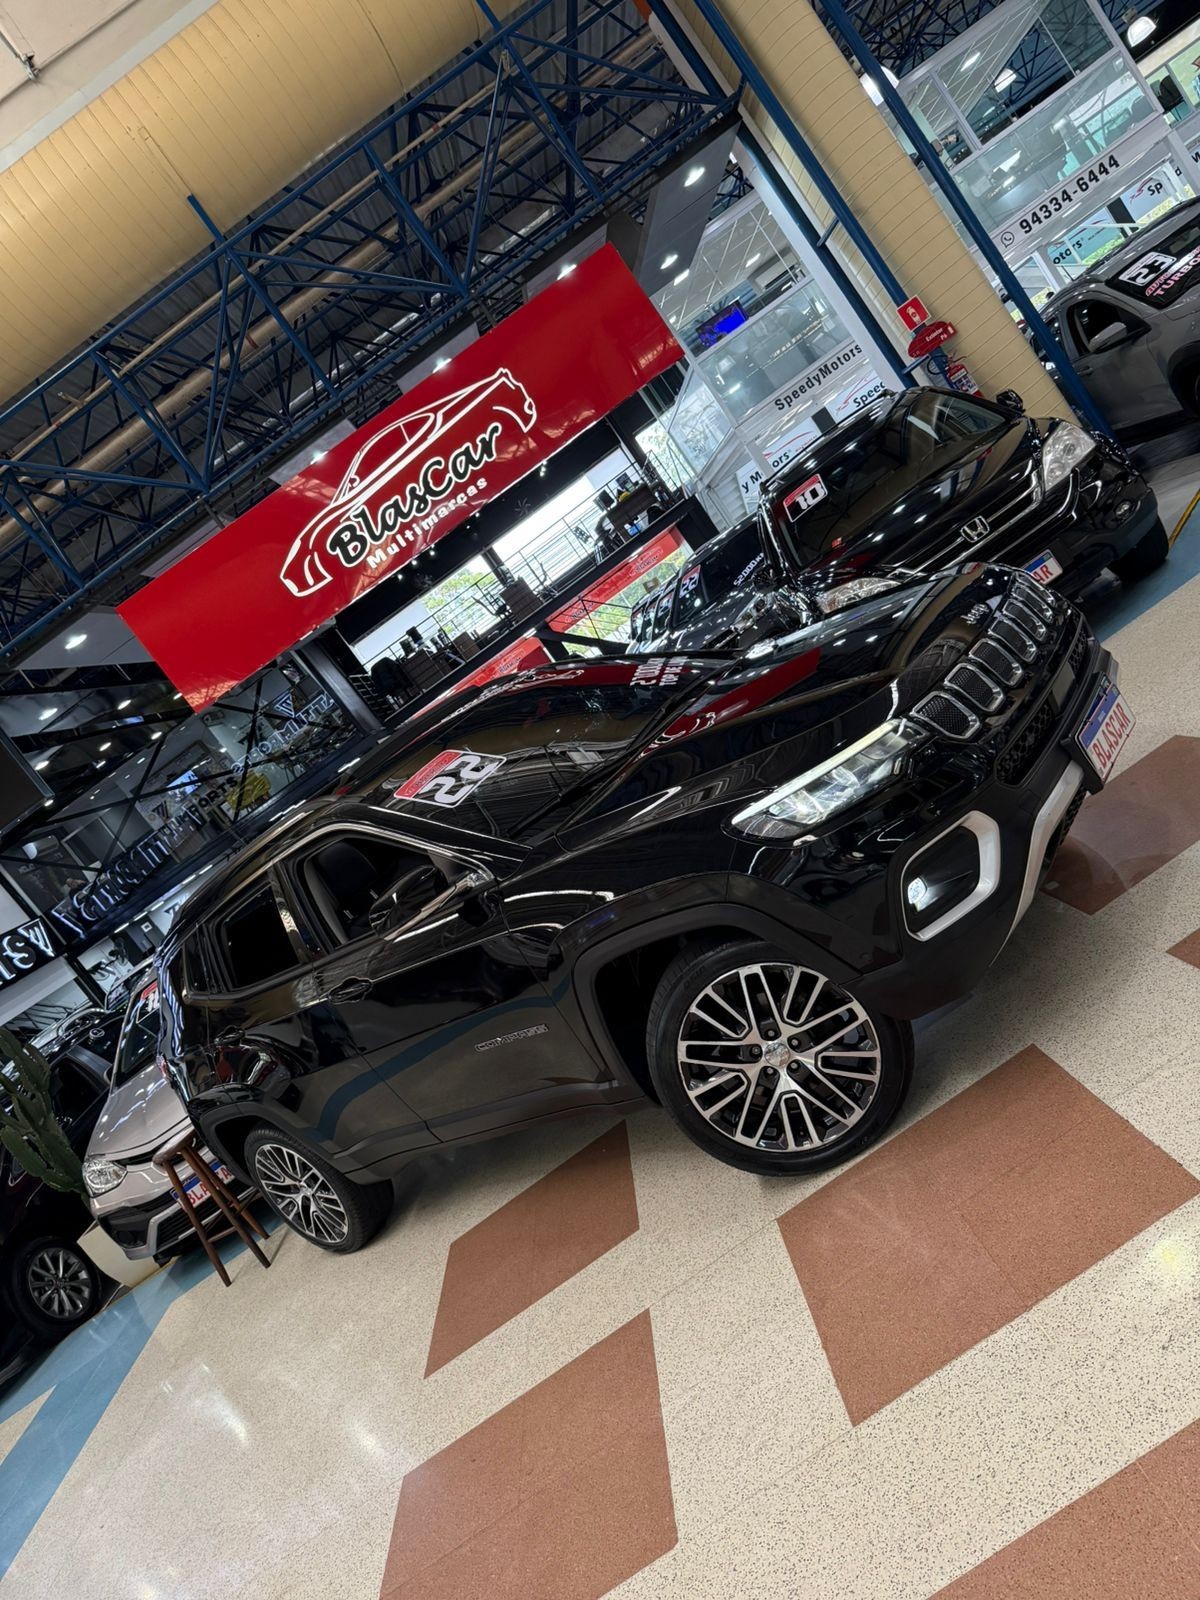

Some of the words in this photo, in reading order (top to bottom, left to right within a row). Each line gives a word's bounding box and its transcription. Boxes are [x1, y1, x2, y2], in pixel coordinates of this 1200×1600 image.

[1019, 154, 1120, 234] 94334-6444
[774, 344, 863, 411] SpeedyMotors
[326, 422, 502, 567] BlasCar
[366, 477, 488, 569] Multimarcas
[795, 481, 826, 510] 10
[1092, 701, 1131, 769] BLASCAR
[418, 755, 499, 804] 22
